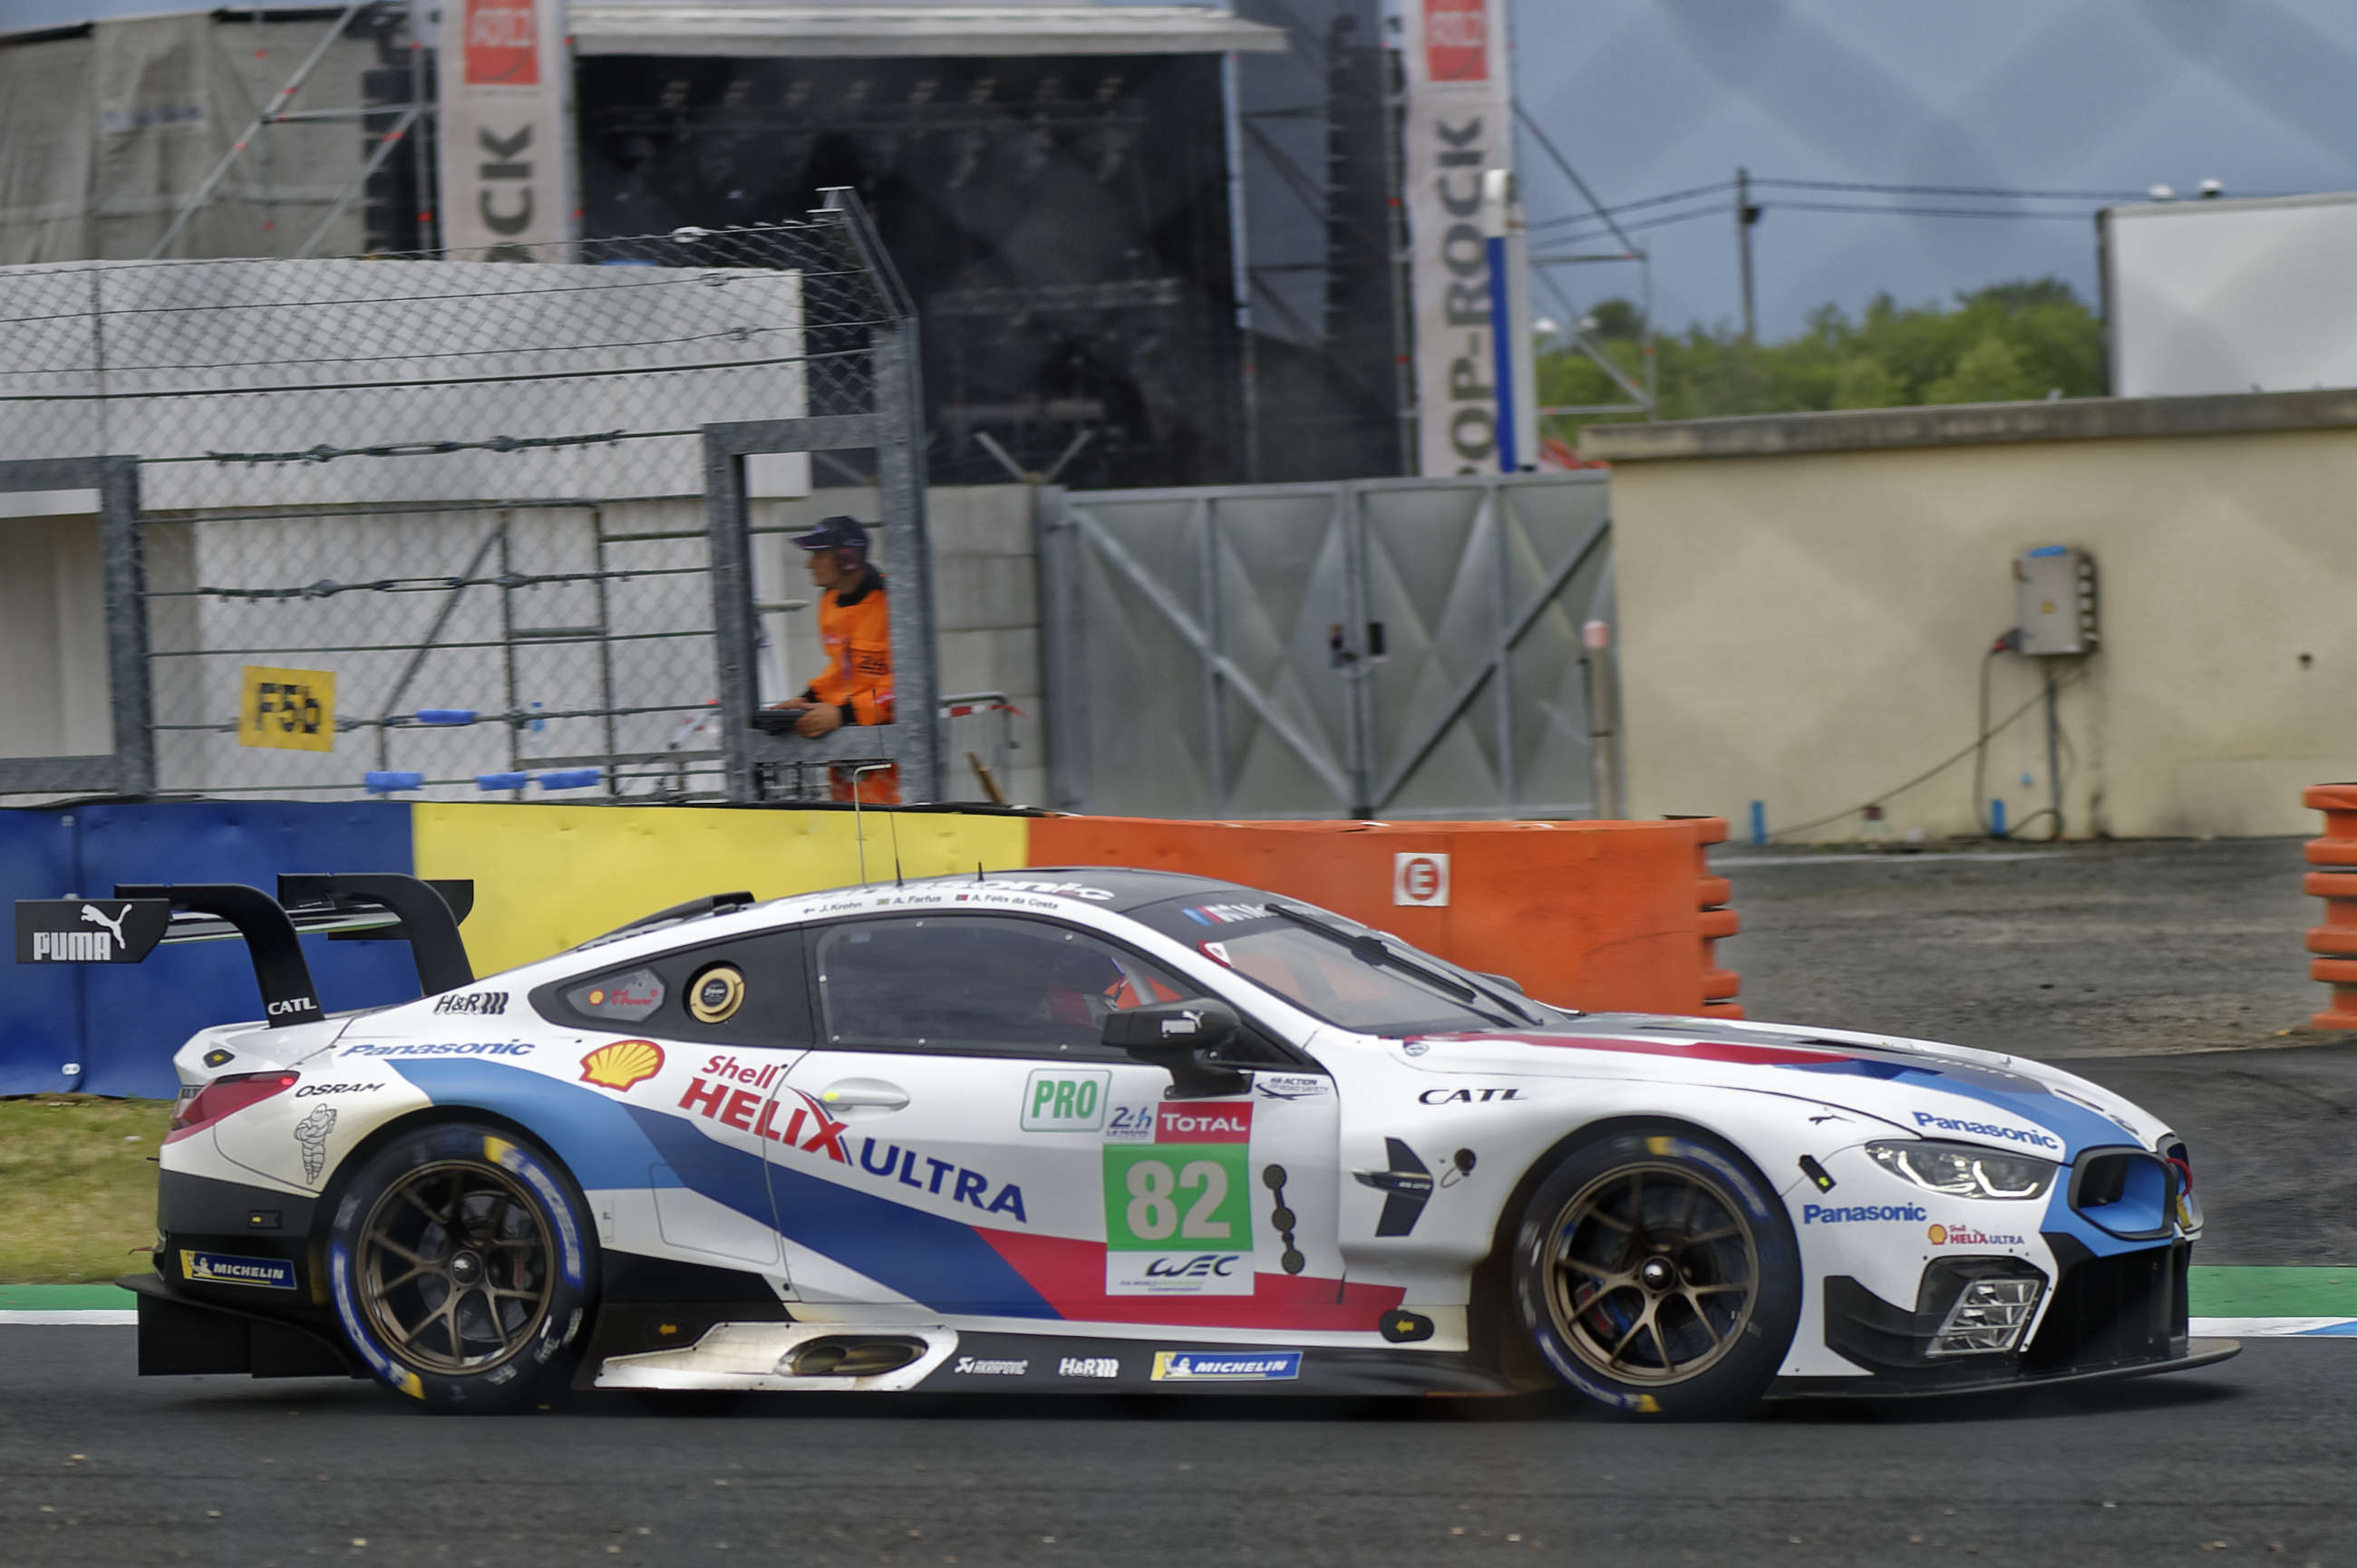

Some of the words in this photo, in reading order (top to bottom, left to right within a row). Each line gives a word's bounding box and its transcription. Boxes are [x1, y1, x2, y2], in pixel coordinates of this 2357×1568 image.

[1436, 115, 1497, 474] OP-ROCK
[907, 895, 942, 904] Farfus
[1028, 897, 1059, 910] Costa
[34, 932, 111, 961] PUMA
[267, 997, 318, 1015] CATL
[339, 1039, 536, 1058] Panasonic
[702, 1055, 780, 1089] Shell
[295, 1082, 385, 1099] OSRAM
[1032, 1079, 1098, 1119] PRO
[1419, 1088, 1529, 1105] CATL
[1162, 1113, 1246, 1132] TOTAL
[1912, 1111, 2059, 1149] Panasonic
[678, 1077, 850, 1165] HELIX
[860, 1137, 1027, 1224] ULTRA
[1126, 1159, 1231, 1241] 82
[1803, 1202, 1927, 1224] Panasonic
[1950, 1231, 1988, 1244] HELIX
[1989, 1234, 2025, 1244] ULTRA
[212, 1263, 284, 1279] MICHELIN
[1145, 1254, 1240, 1277] WEC
[1195, 1360, 1288, 1373] MICHELIN
